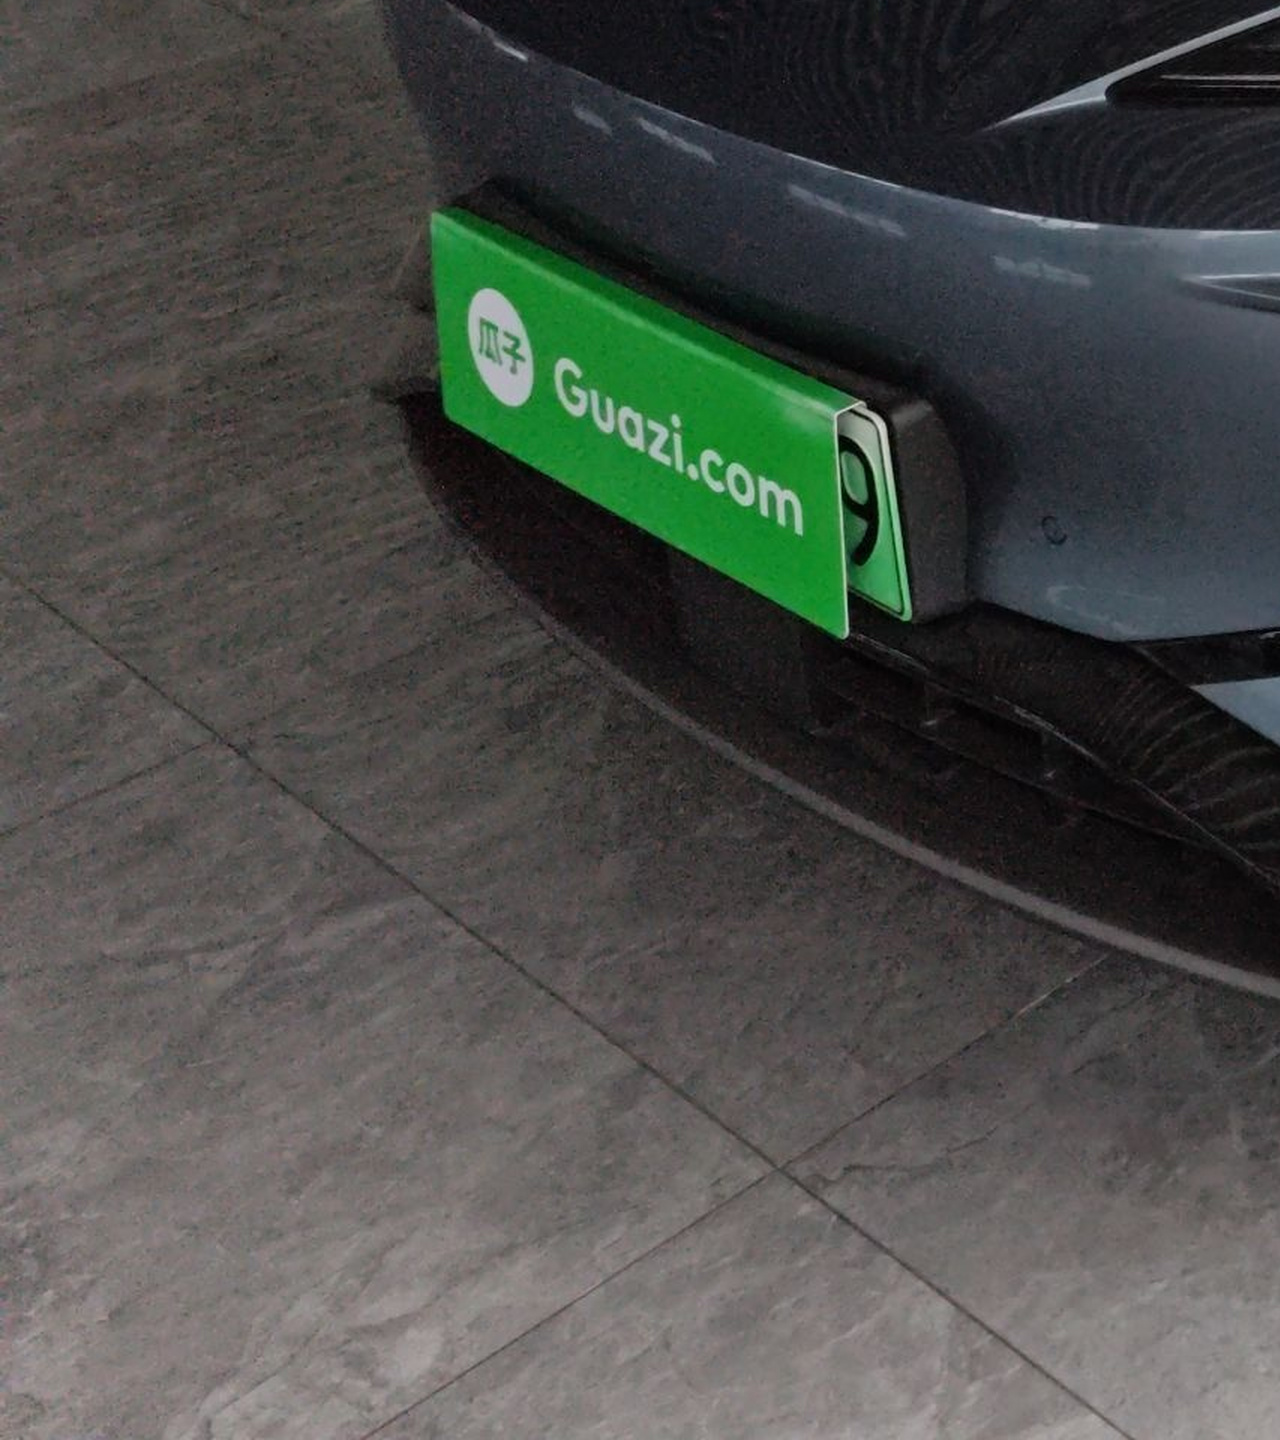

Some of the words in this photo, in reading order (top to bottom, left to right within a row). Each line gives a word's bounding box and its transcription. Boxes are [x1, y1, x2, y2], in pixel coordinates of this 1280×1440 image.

[479, 316, 526, 374] 瓜子
[554, 357, 804, 536] Guazi.com
[837, 433, 880, 567] 9
